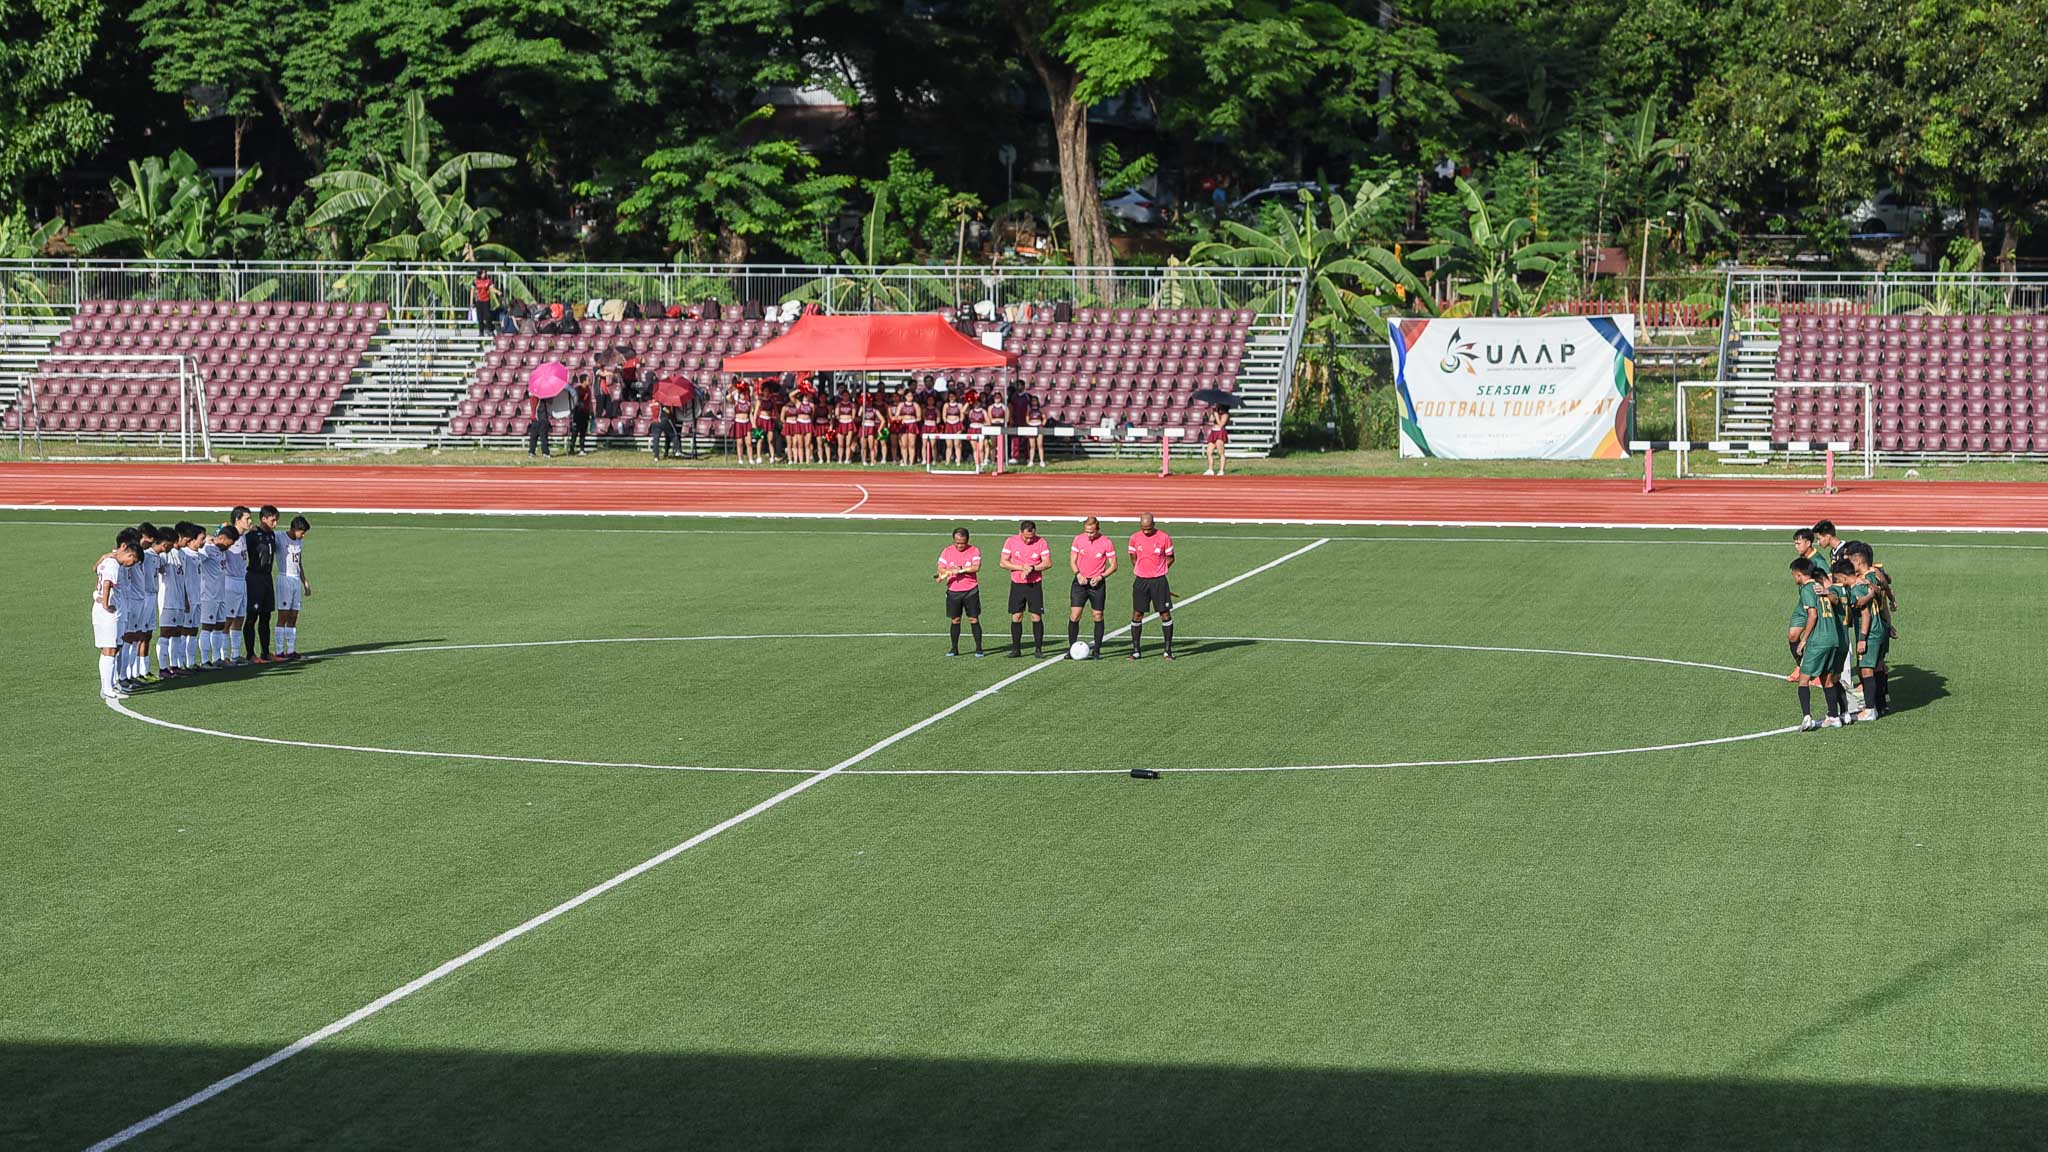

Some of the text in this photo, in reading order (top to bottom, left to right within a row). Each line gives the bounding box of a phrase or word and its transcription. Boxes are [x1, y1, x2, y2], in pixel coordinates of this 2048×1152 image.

[1486, 343, 1576, 364] UAAP
[1476, 384, 1556, 396] SEASON 85
[1415, 398, 1615, 417] FOOTBALL TOURAMNT
[291, 552, 299, 563] 15
